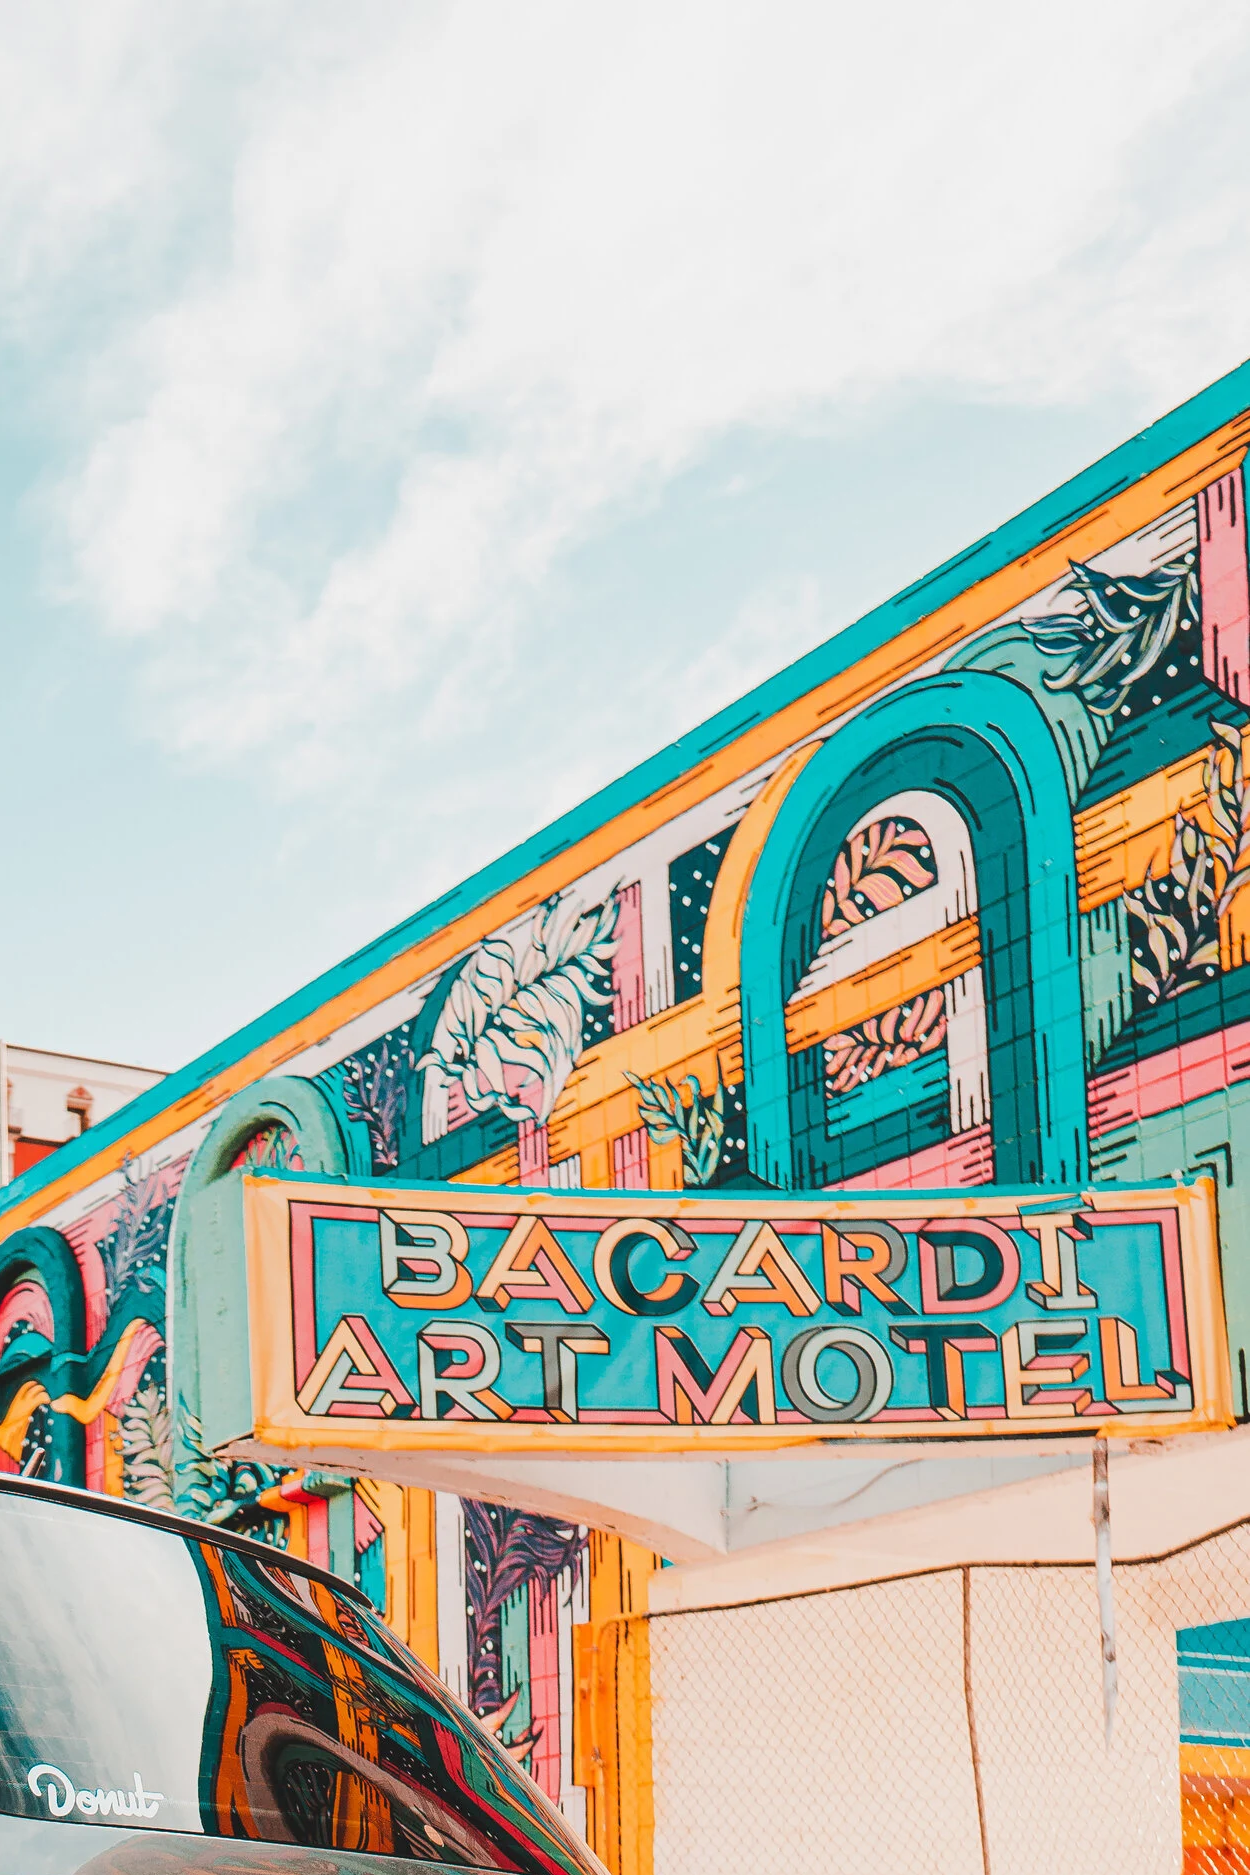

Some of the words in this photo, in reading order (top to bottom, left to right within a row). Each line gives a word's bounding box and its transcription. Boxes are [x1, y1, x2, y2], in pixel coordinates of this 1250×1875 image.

[379, 1208, 1098, 1316] BACARDI
[296, 1314, 611, 1423] ART
[654, 1317, 1193, 1425] MOTEL
[28, 1763, 165, 1819] Donut
